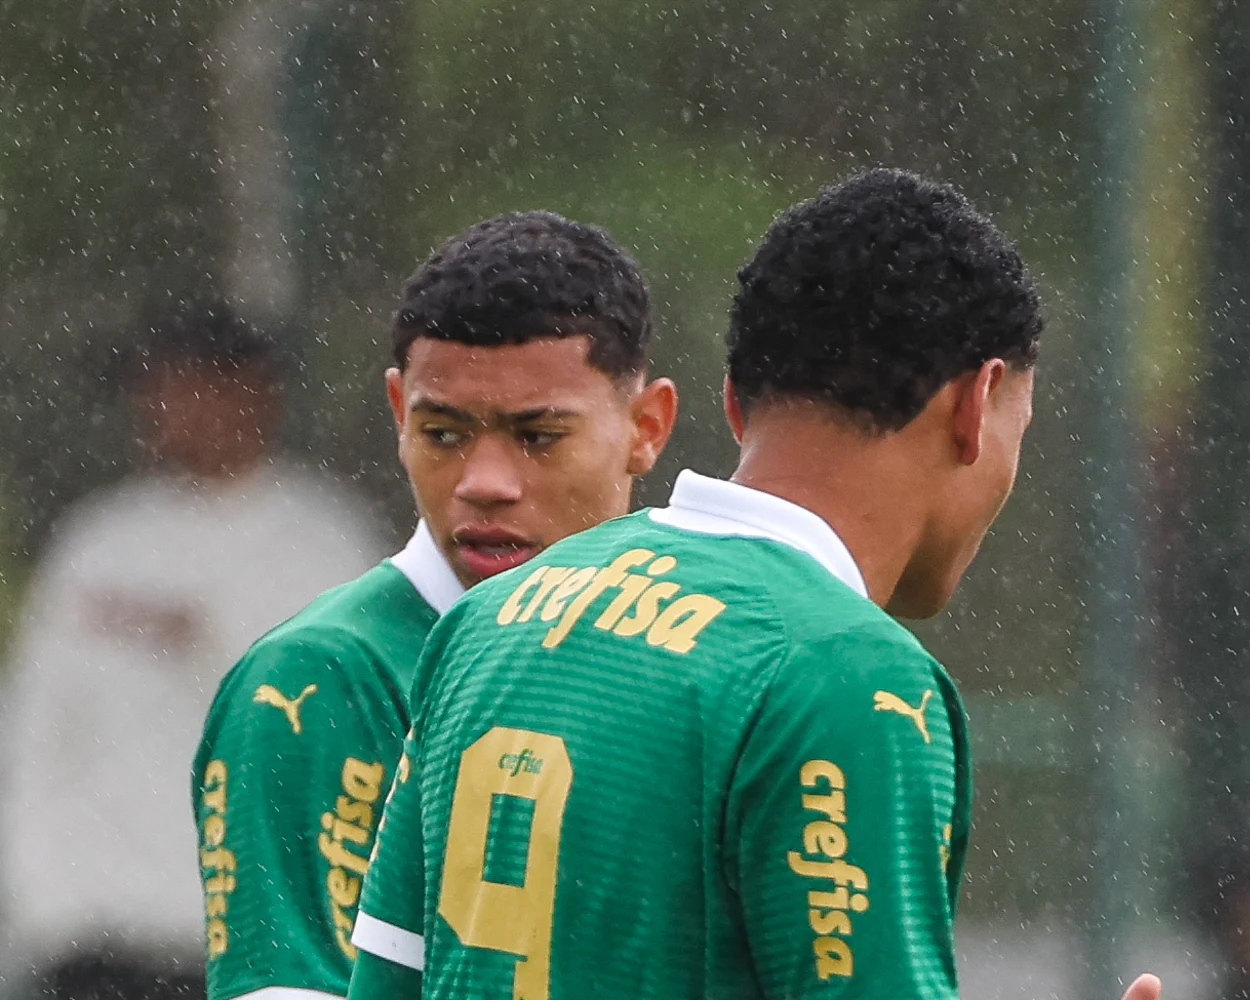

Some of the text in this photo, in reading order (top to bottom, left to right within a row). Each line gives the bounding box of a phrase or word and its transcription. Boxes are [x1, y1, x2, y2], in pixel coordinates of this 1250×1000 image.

[496, 548, 728, 654] crefisa
[203, 759, 237, 956] crefisa
[800, 759, 869, 981] crefisa
